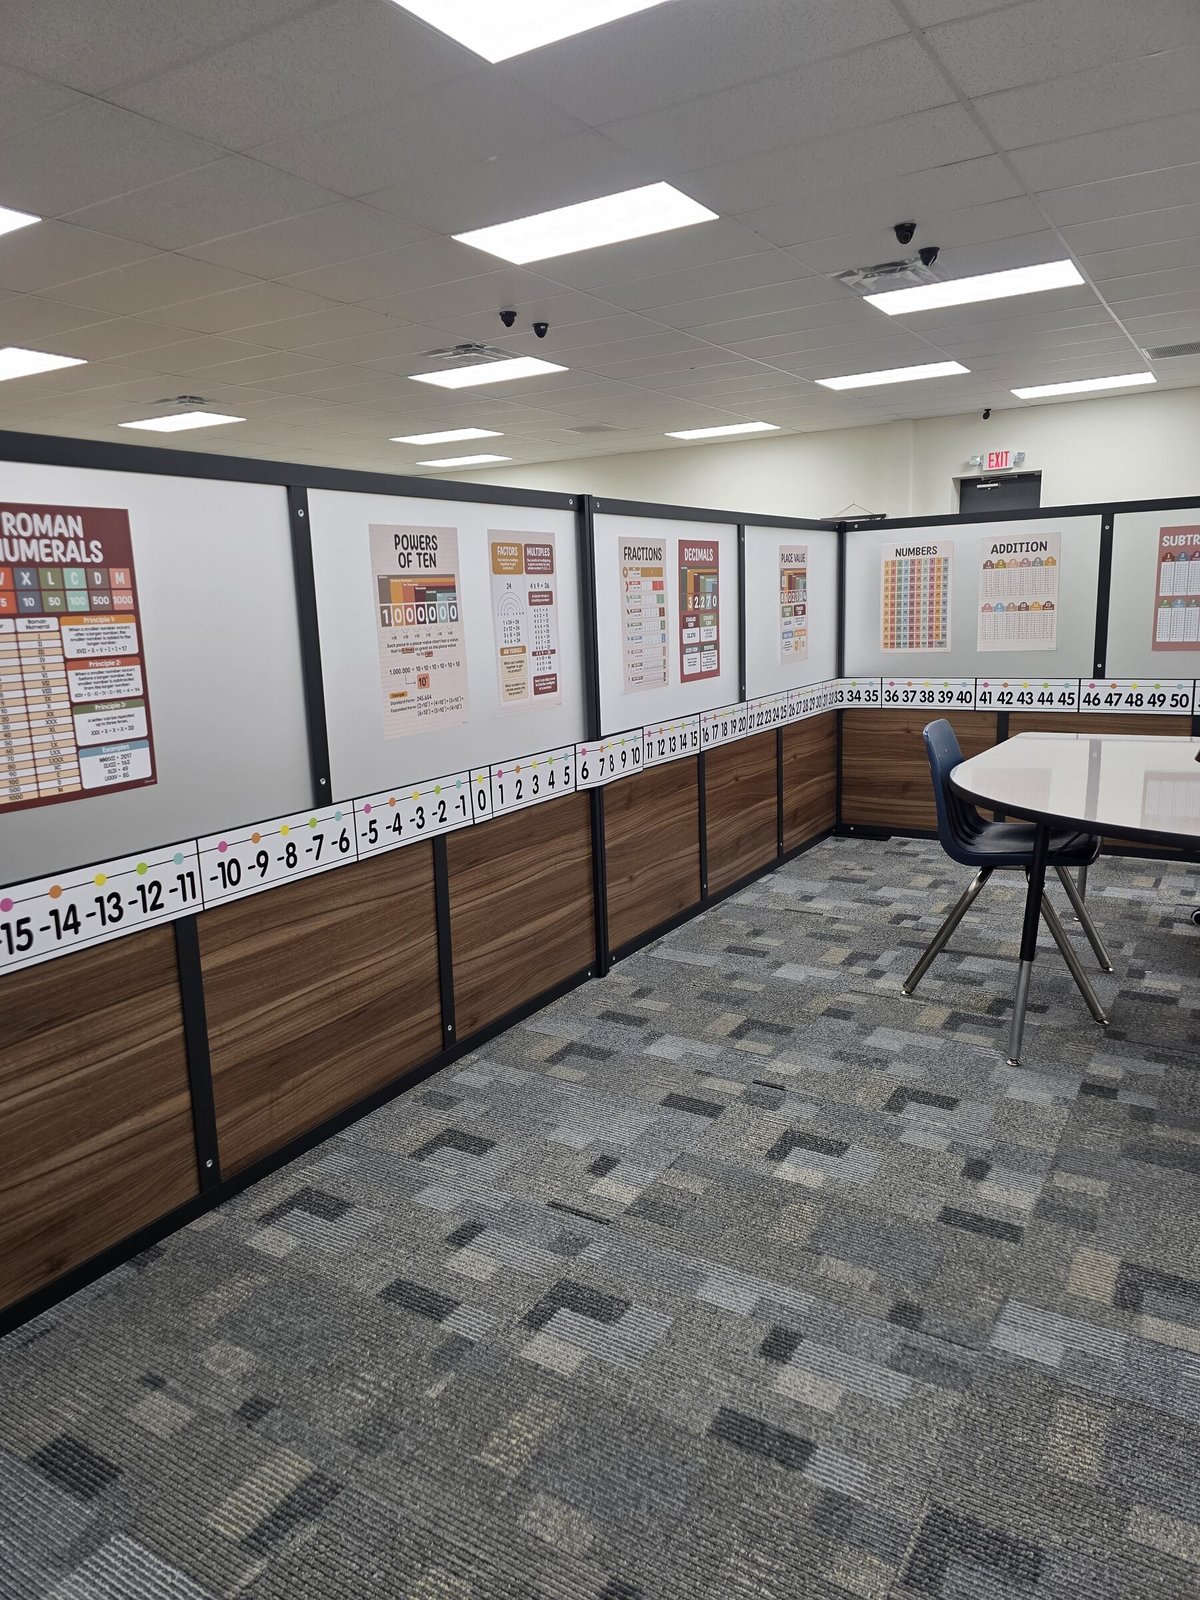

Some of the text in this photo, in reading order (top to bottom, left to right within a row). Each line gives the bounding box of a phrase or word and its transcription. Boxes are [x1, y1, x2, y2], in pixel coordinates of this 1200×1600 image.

[988, 450, 1010, 468] EXIT
[1, 512, 84, 538] ROMAN
[0, 538, 104, 563] UMERALS
[394, 534, 438, 551] POWERS
[990, 541, 1048, 555] ADDITION
[497, 546, 518, 556] FACTORS
[527, 547, 550, 557] MULTIPLES
[624, 546, 662, 561] FRACTIONS
[684, 548, 714, 561] DECIMALS
[781, 553, 806, 563] PLACE VALUE
[895, 546, 938, 557] NUMBERS
[398, 552, 437, 568] OF TEN
[21, 572, 31, 585] X
[48, 572, 55, 585] L
[71, 572, 79, 585] C
[94, 572, 101, 585] D
[115, 572, 125, 585] M
[23, 598, 35, 607] 10
[48, 597, 61, 606] 50
[70, 597, 86, 605] 100
[92, 596, 110, 605] 500
[112, 596, 133, 604] 1000
[847, 690, 861, 702] 34
[864, 690, 878, 702] 35
[884, 690, 972, 704] 36 37 38 39 40
[979, 691, 1075, 706] 41 42 43 44 45
[1083, 693, 1100, 706] 46
[1104, 693, 1122, 706] 47
[1125, 693, 1143, 707] 48
[1147, 694, 1166, 707] 49
[1170, 694, 1189, 708] 50
[789, 695, 821, 717] 26 27 28 29 30
[749, 705, 787, 729] 21 22 23 24 25
[702, 717, 746, 743] 16 17 18 19 20
[647, 731, 698, 759] 11 12 13 14 15
[581, 747, 640, 779] 6 7 8 9 10
[499, 766, 570, 804] 1 2 3 4 5
[478, 789, 486, 811] 0
[361, 795, 466, 844] -5 -4 -3 -2 -1
[210, 828, 350, 889] -10 -9 -8 -7 -6
[0, 871, 196, 955] 15 -14 -13 -12 -11
